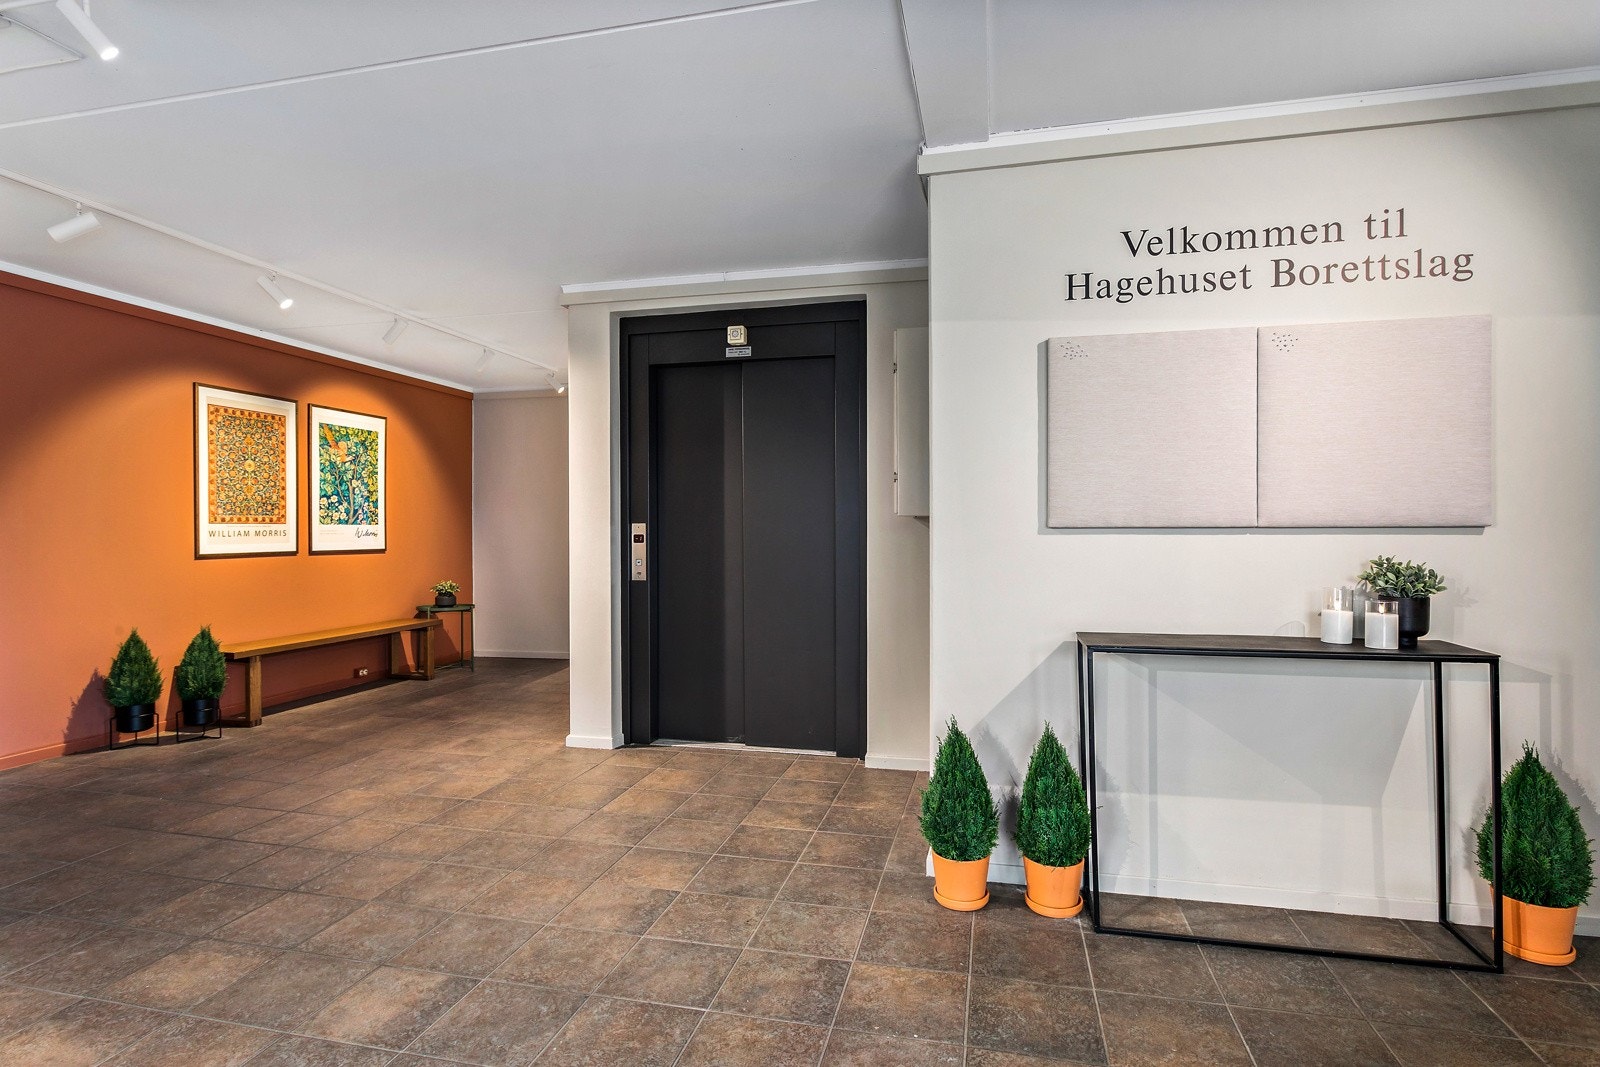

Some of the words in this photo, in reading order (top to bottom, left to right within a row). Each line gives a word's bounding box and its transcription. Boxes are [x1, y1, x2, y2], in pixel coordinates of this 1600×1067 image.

[1121, 220, 1345, 258] Velkommen
[1364, 207, 1408, 241] til
[1065, 264, 1253, 303] Hagehuset
[1271, 248, 1475, 288] Borettslag
[208, 530, 250, 538] WILLIAM
[254, 529, 288, 537] MORRIS
